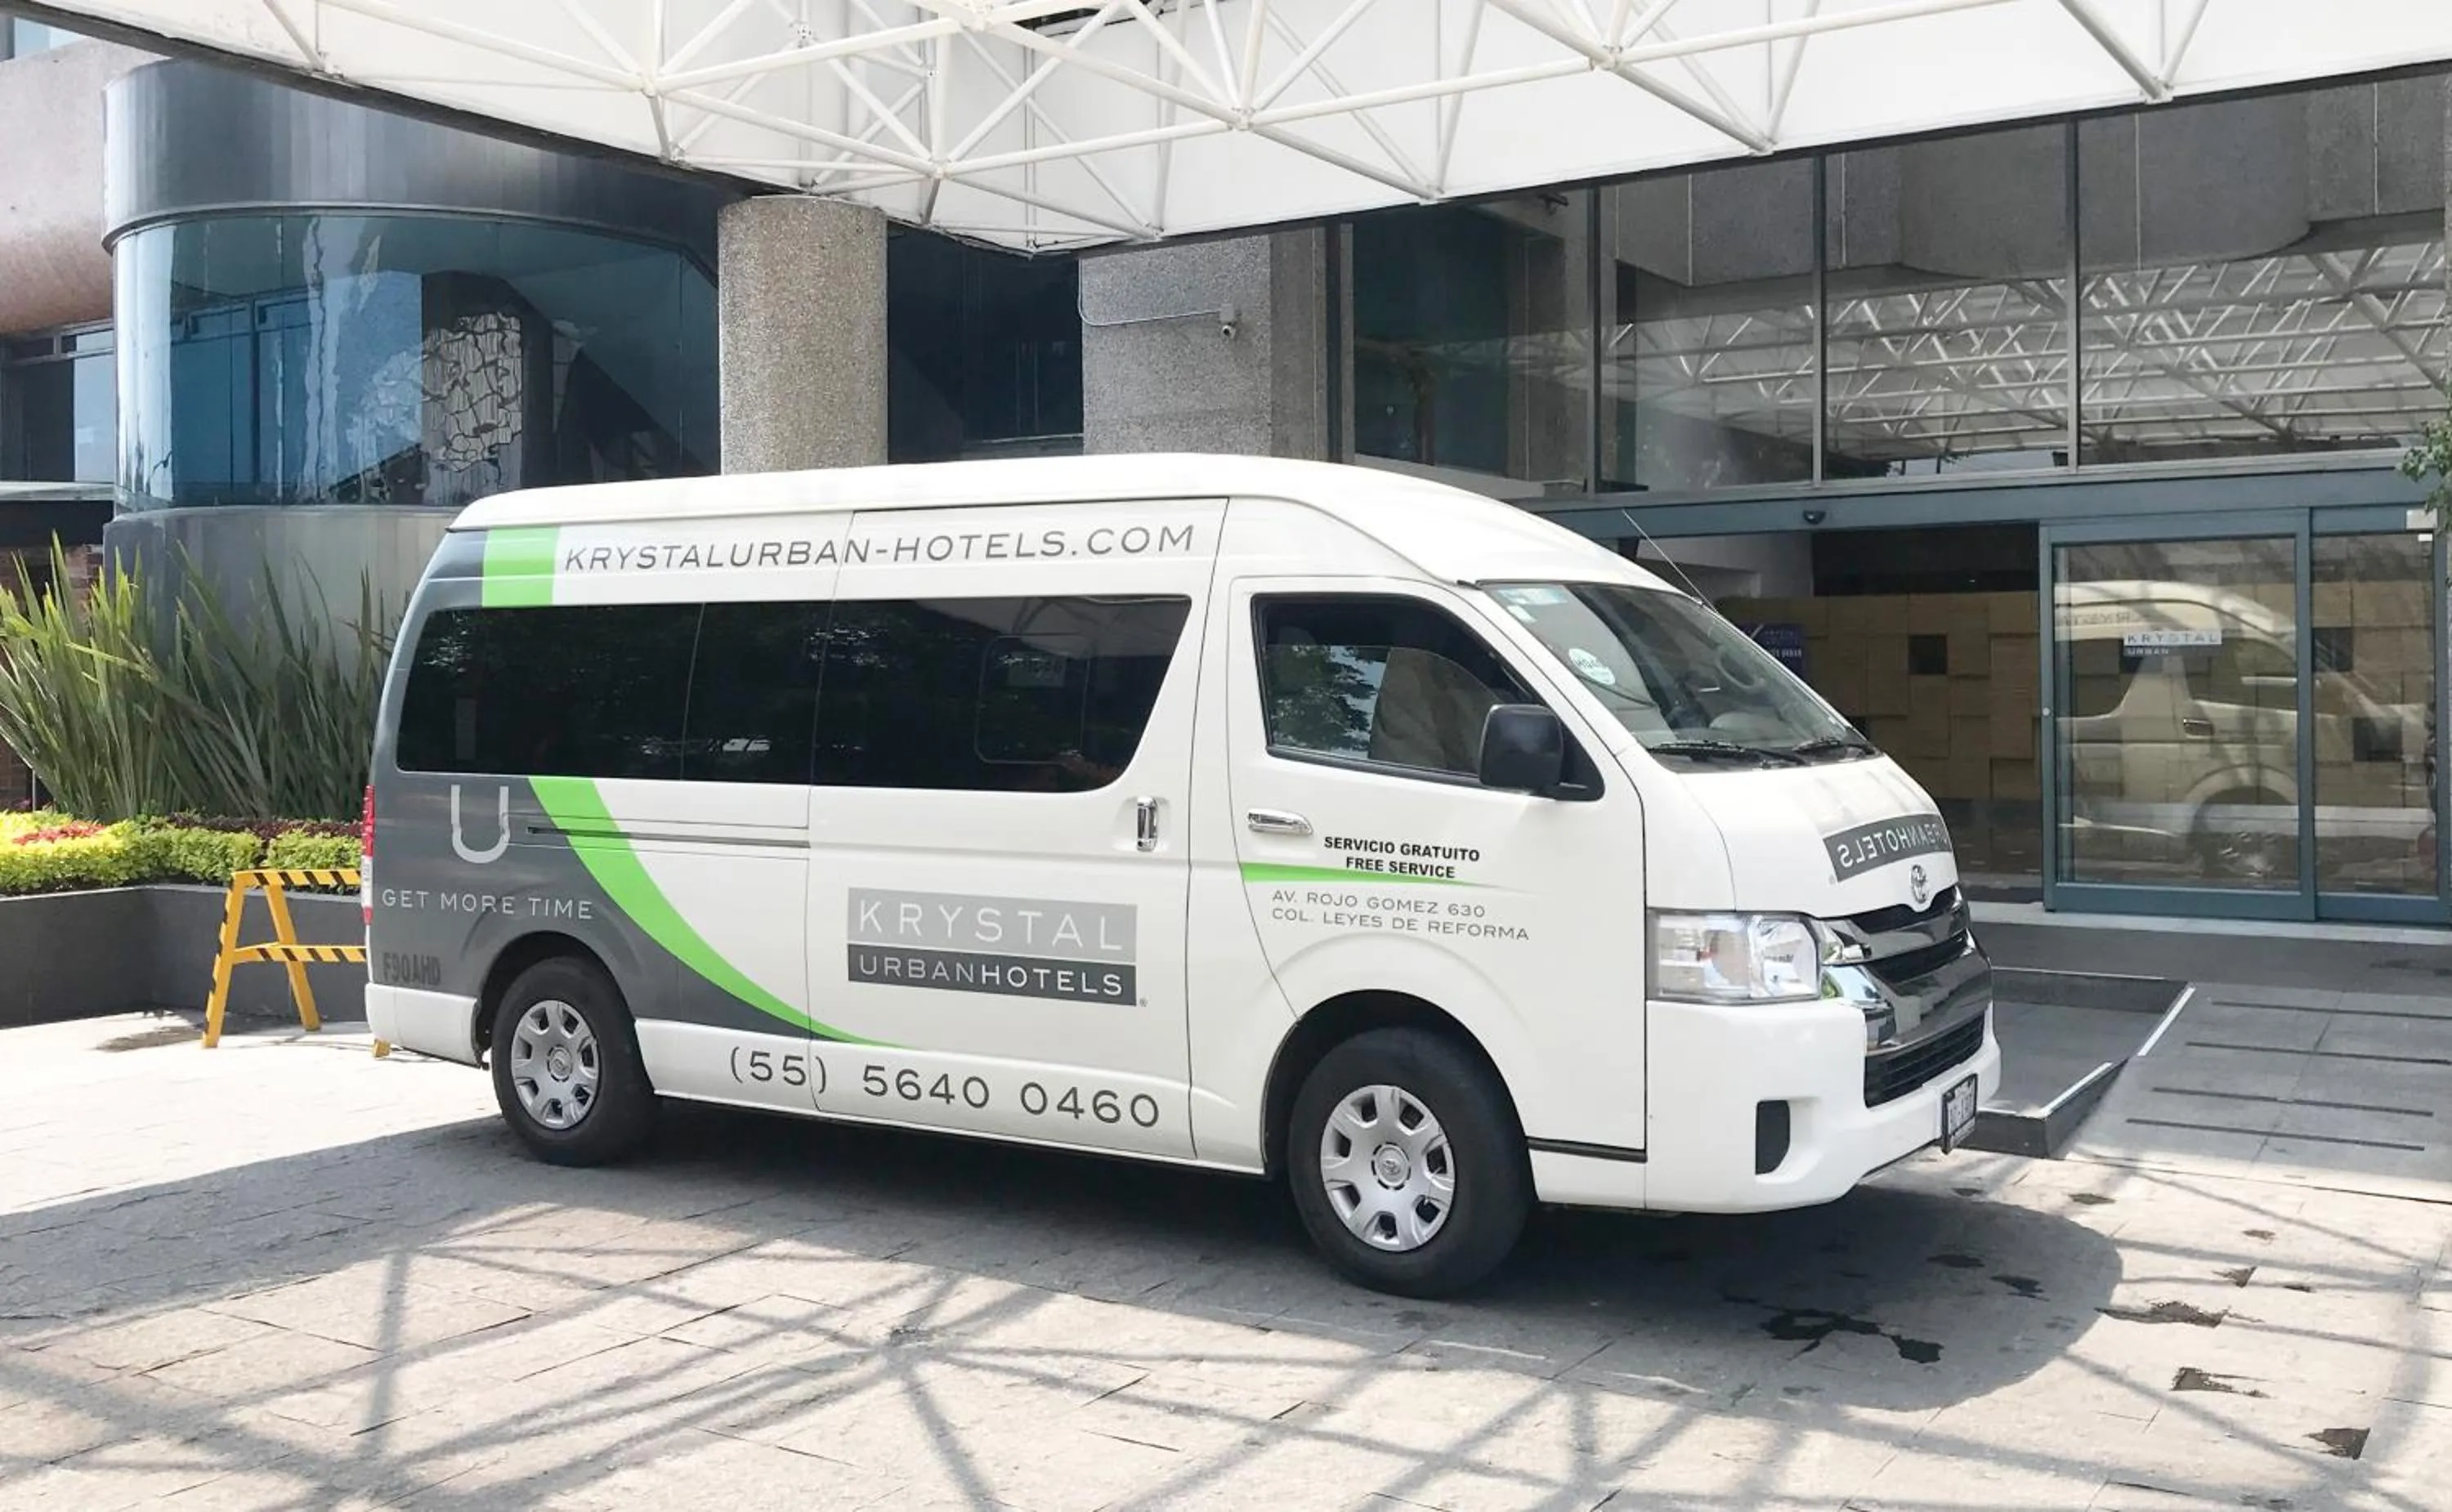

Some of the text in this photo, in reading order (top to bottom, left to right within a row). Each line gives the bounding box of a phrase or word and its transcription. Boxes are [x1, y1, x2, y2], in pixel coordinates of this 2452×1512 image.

[565, 524, 1194, 572] KRYSTALURBAN-HOTELS.COM
[2127, 633, 2217, 643] KRYSTAL
[450, 784, 511, 864] U
[1324, 836, 1480, 862] SERVICIO GRATUITO
[1346, 856, 1456, 879] FREE SERVICE
[382, 888, 593, 919] GET MORE TIME
[1272, 889, 1486, 918] AV. ROJO GOMEZ 630
[858, 900, 1123, 951] KRYSTAL
[1272, 908, 1529, 941] COL. LEYES DE REFORMA
[859, 955, 1123, 996] URBANHOTELS
[730, 1046, 1160, 1128] (55) 5640 0460
